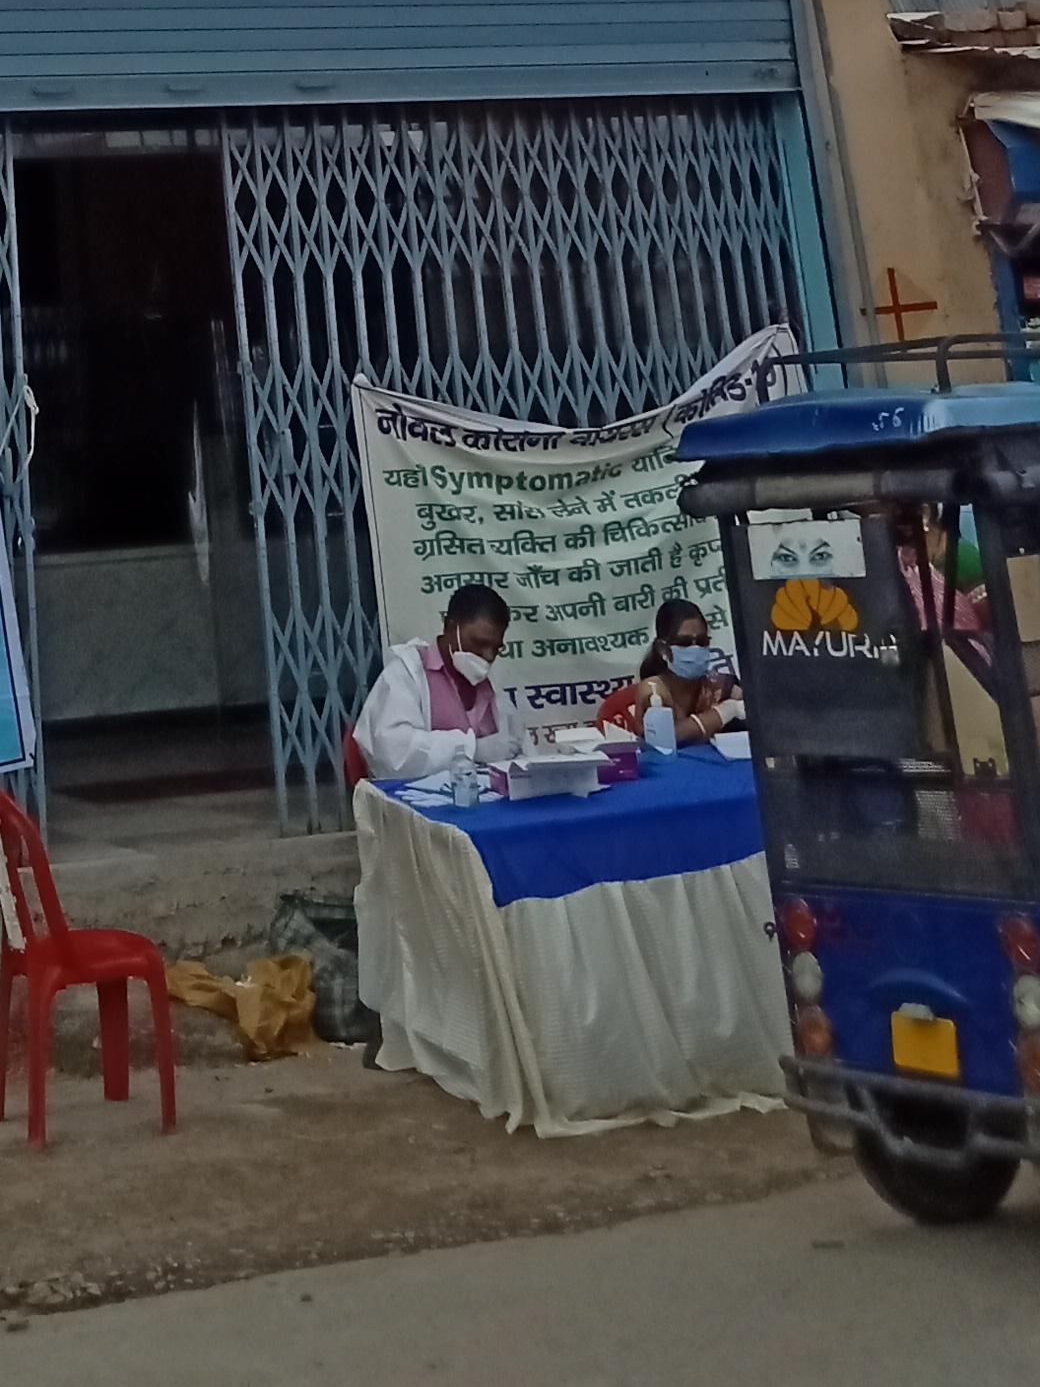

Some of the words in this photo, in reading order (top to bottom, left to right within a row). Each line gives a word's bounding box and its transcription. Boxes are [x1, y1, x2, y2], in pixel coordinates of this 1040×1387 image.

[430, 463, 622, 496] Symptomatic
[412, 530, 486, 561] ग्रसित
[563, 524, 596, 550] की
[567, 558, 602, 583] की
[607, 547, 664, 578] जाती
[545, 591, 607, 622] अपनी
[613, 584, 657, 613] बारी
[531, 627, 650, 658] अनावश्यक
